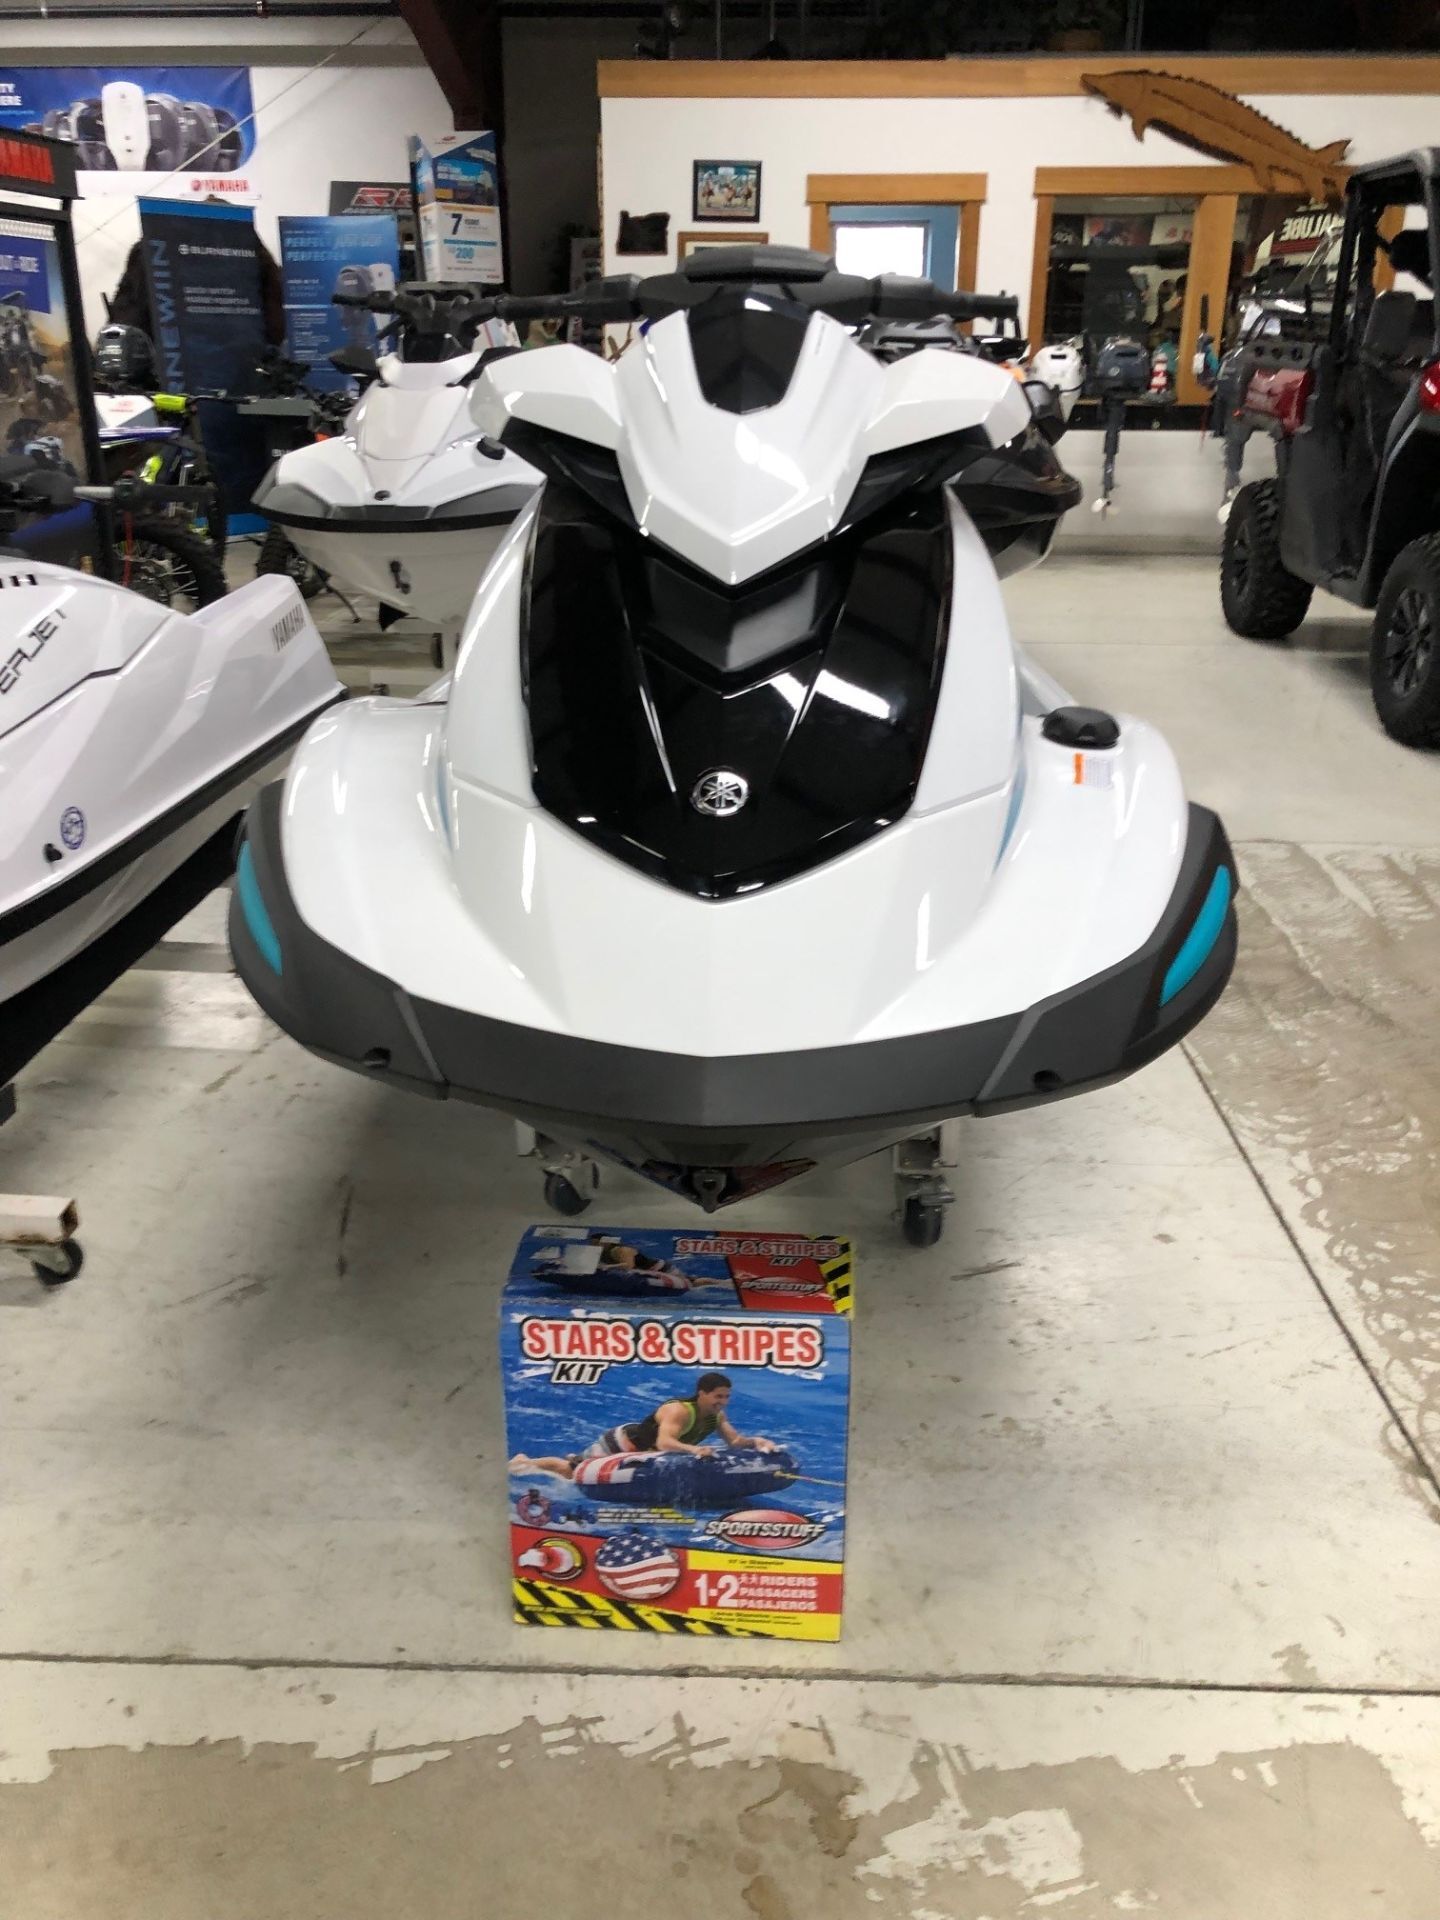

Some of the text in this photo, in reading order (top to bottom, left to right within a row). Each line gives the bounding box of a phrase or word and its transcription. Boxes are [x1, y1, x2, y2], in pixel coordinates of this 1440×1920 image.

[451, 213, 462, 235] 7
[272, 604, 306, 652] YAMAHA
[677, 1239, 840, 1257] STARS & STRIPES
[770, 1257, 801, 1267] KIT
[740, 1280, 825, 1293] SPORTSSTUFF
[523, 1319, 822, 1367] STARS & STRIPES
[551, 1361, 609, 1384] KIT
[705, 1518, 827, 1541] SPORTSSTUFF
[694, 1573, 738, 1607] 1-2
[760, 1576, 818, 1587] RIDERS
[740, 1588, 817, 1599] PASSAGERS
[738, 1599, 817, 1611] PASAJEROS
